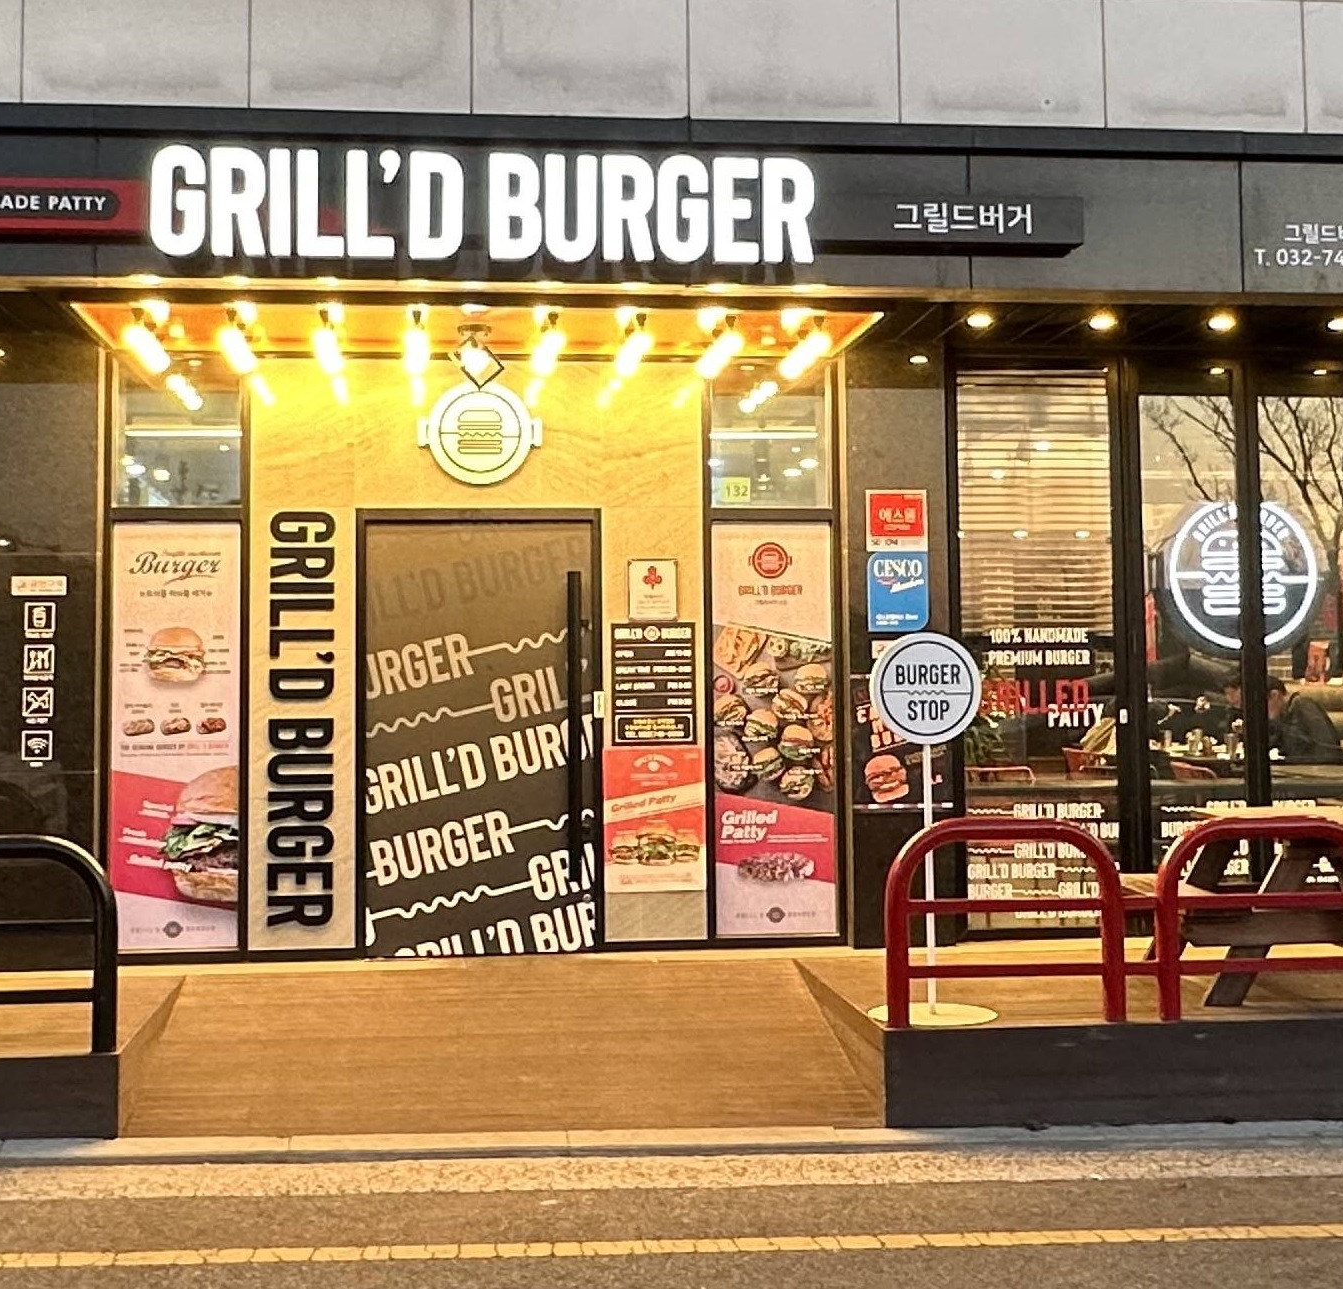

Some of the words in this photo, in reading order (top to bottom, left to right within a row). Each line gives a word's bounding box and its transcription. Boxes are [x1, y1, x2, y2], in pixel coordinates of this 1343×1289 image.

[48, 195, 106, 211] PATTY
[149, 143, 464, 260] GRILL'D
[487, 151, 816, 265] BURGER
[893, 203, 1033, 235] 그릴드버거
[1254, 248, 1271, 266] T.
[724, 483, 749, 497] 132
[128, 551, 222, 581] Burger
[873, 558, 923, 578] CESCO
[268, 511, 336, 700] GRILL'D
[989, 628, 1022, 645] 100%
[1023, 627, 1089, 644] HANDMADE
[366, 633, 475, 700] URGER
[988, 649, 1043, 666] PREMIUM
[1044, 649, 1091, 665] BURGER
[895, 663, 961, 685] BURGER
[907, 699, 950, 721] STOP
[1047, 703, 1105, 729] PATTY
[721, 809, 779, 825] Grilled
[1013, 803, 1055, 819] GRILL'D
[1056, 802, 1102, 819] BURGER
[266, 717, 335, 927] BURGER
[720, 825, 768, 841] Patty
[369, 810, 515, 887] BURGER
[967, 863, 1009, 880] GRILL'D
[1011, 862, 1056, 879] BURGER
